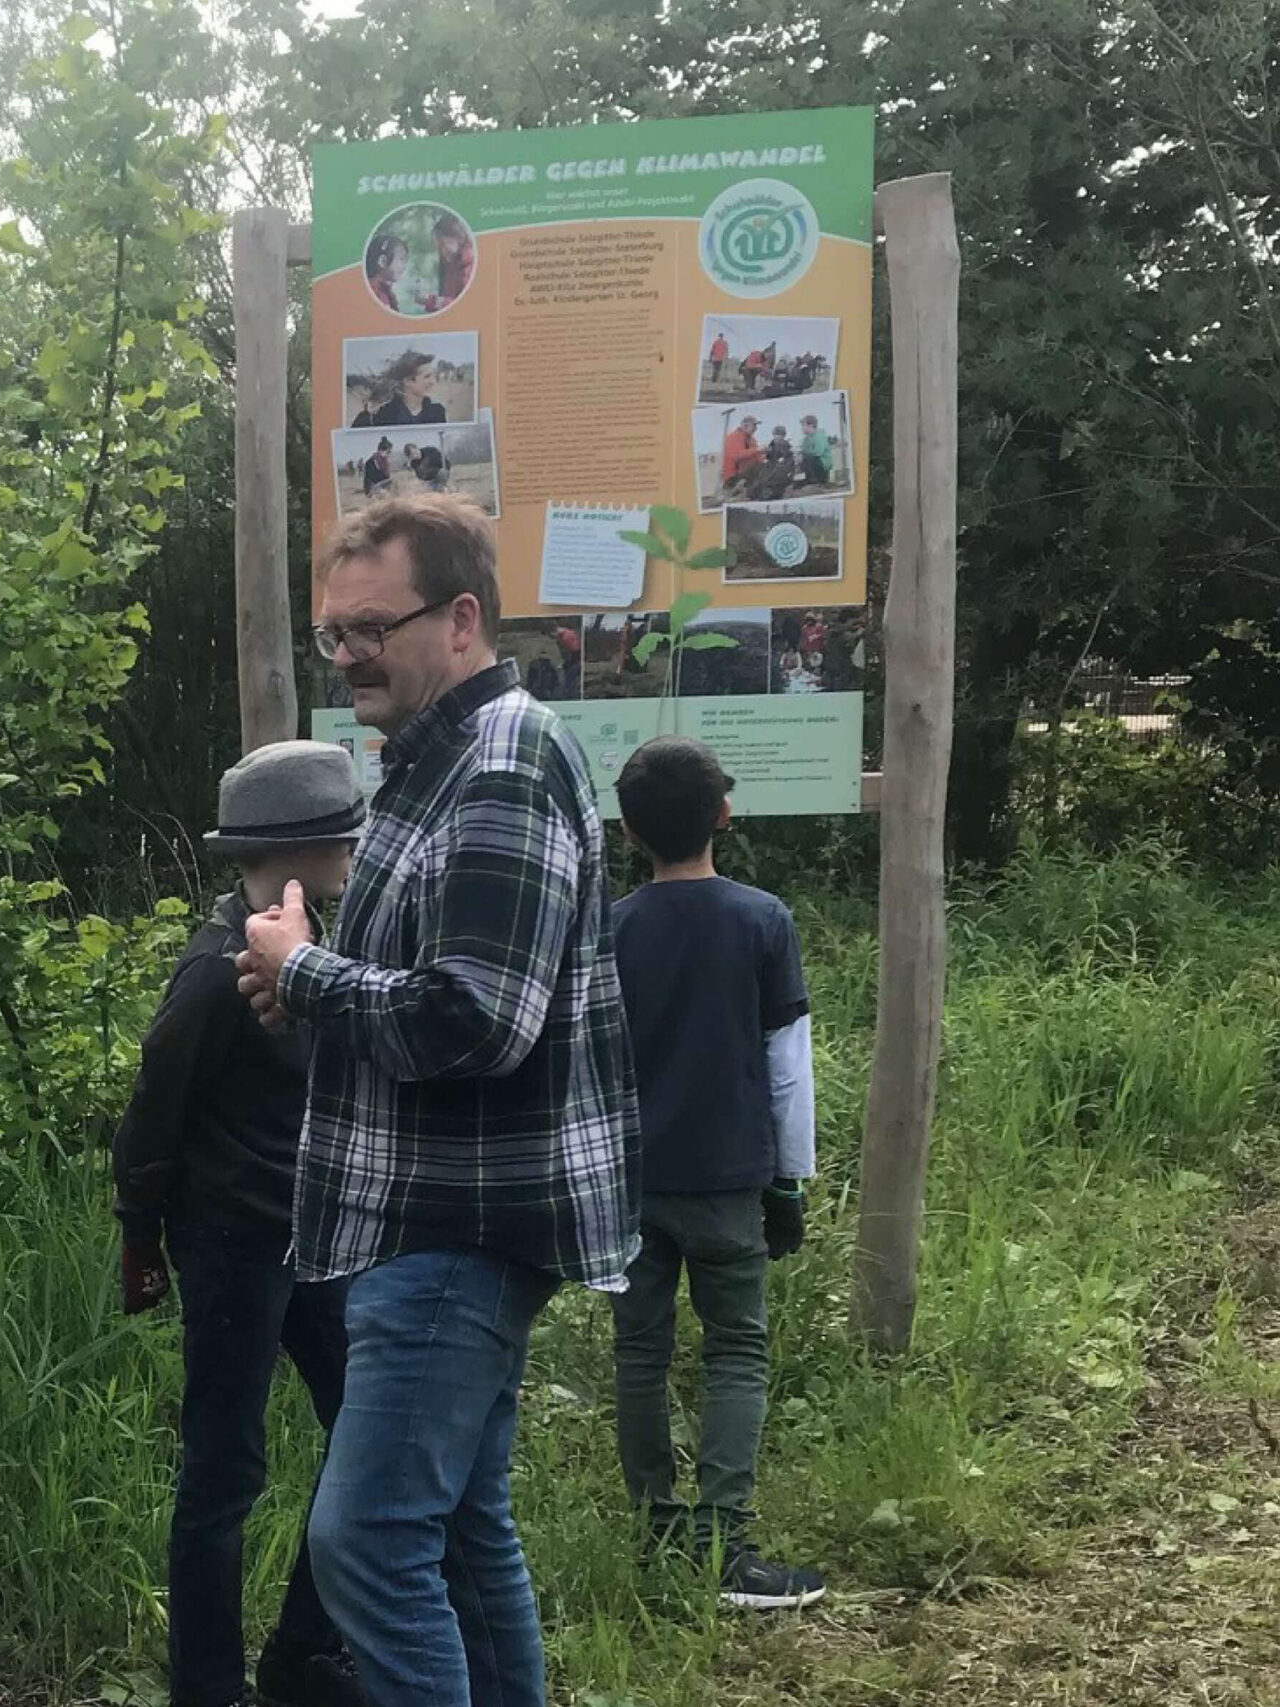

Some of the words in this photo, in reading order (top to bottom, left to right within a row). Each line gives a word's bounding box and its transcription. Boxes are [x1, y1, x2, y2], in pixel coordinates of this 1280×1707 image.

[357, 163, 536, 195] SCHULWÄLDER
[546, 158, 627, 182] GEGEN
[636, 145, 826, 176] KLIMAWANDEL
[520, 236, 575, 247] Grundschule
[510, 248, 566, 259] Grundschule
